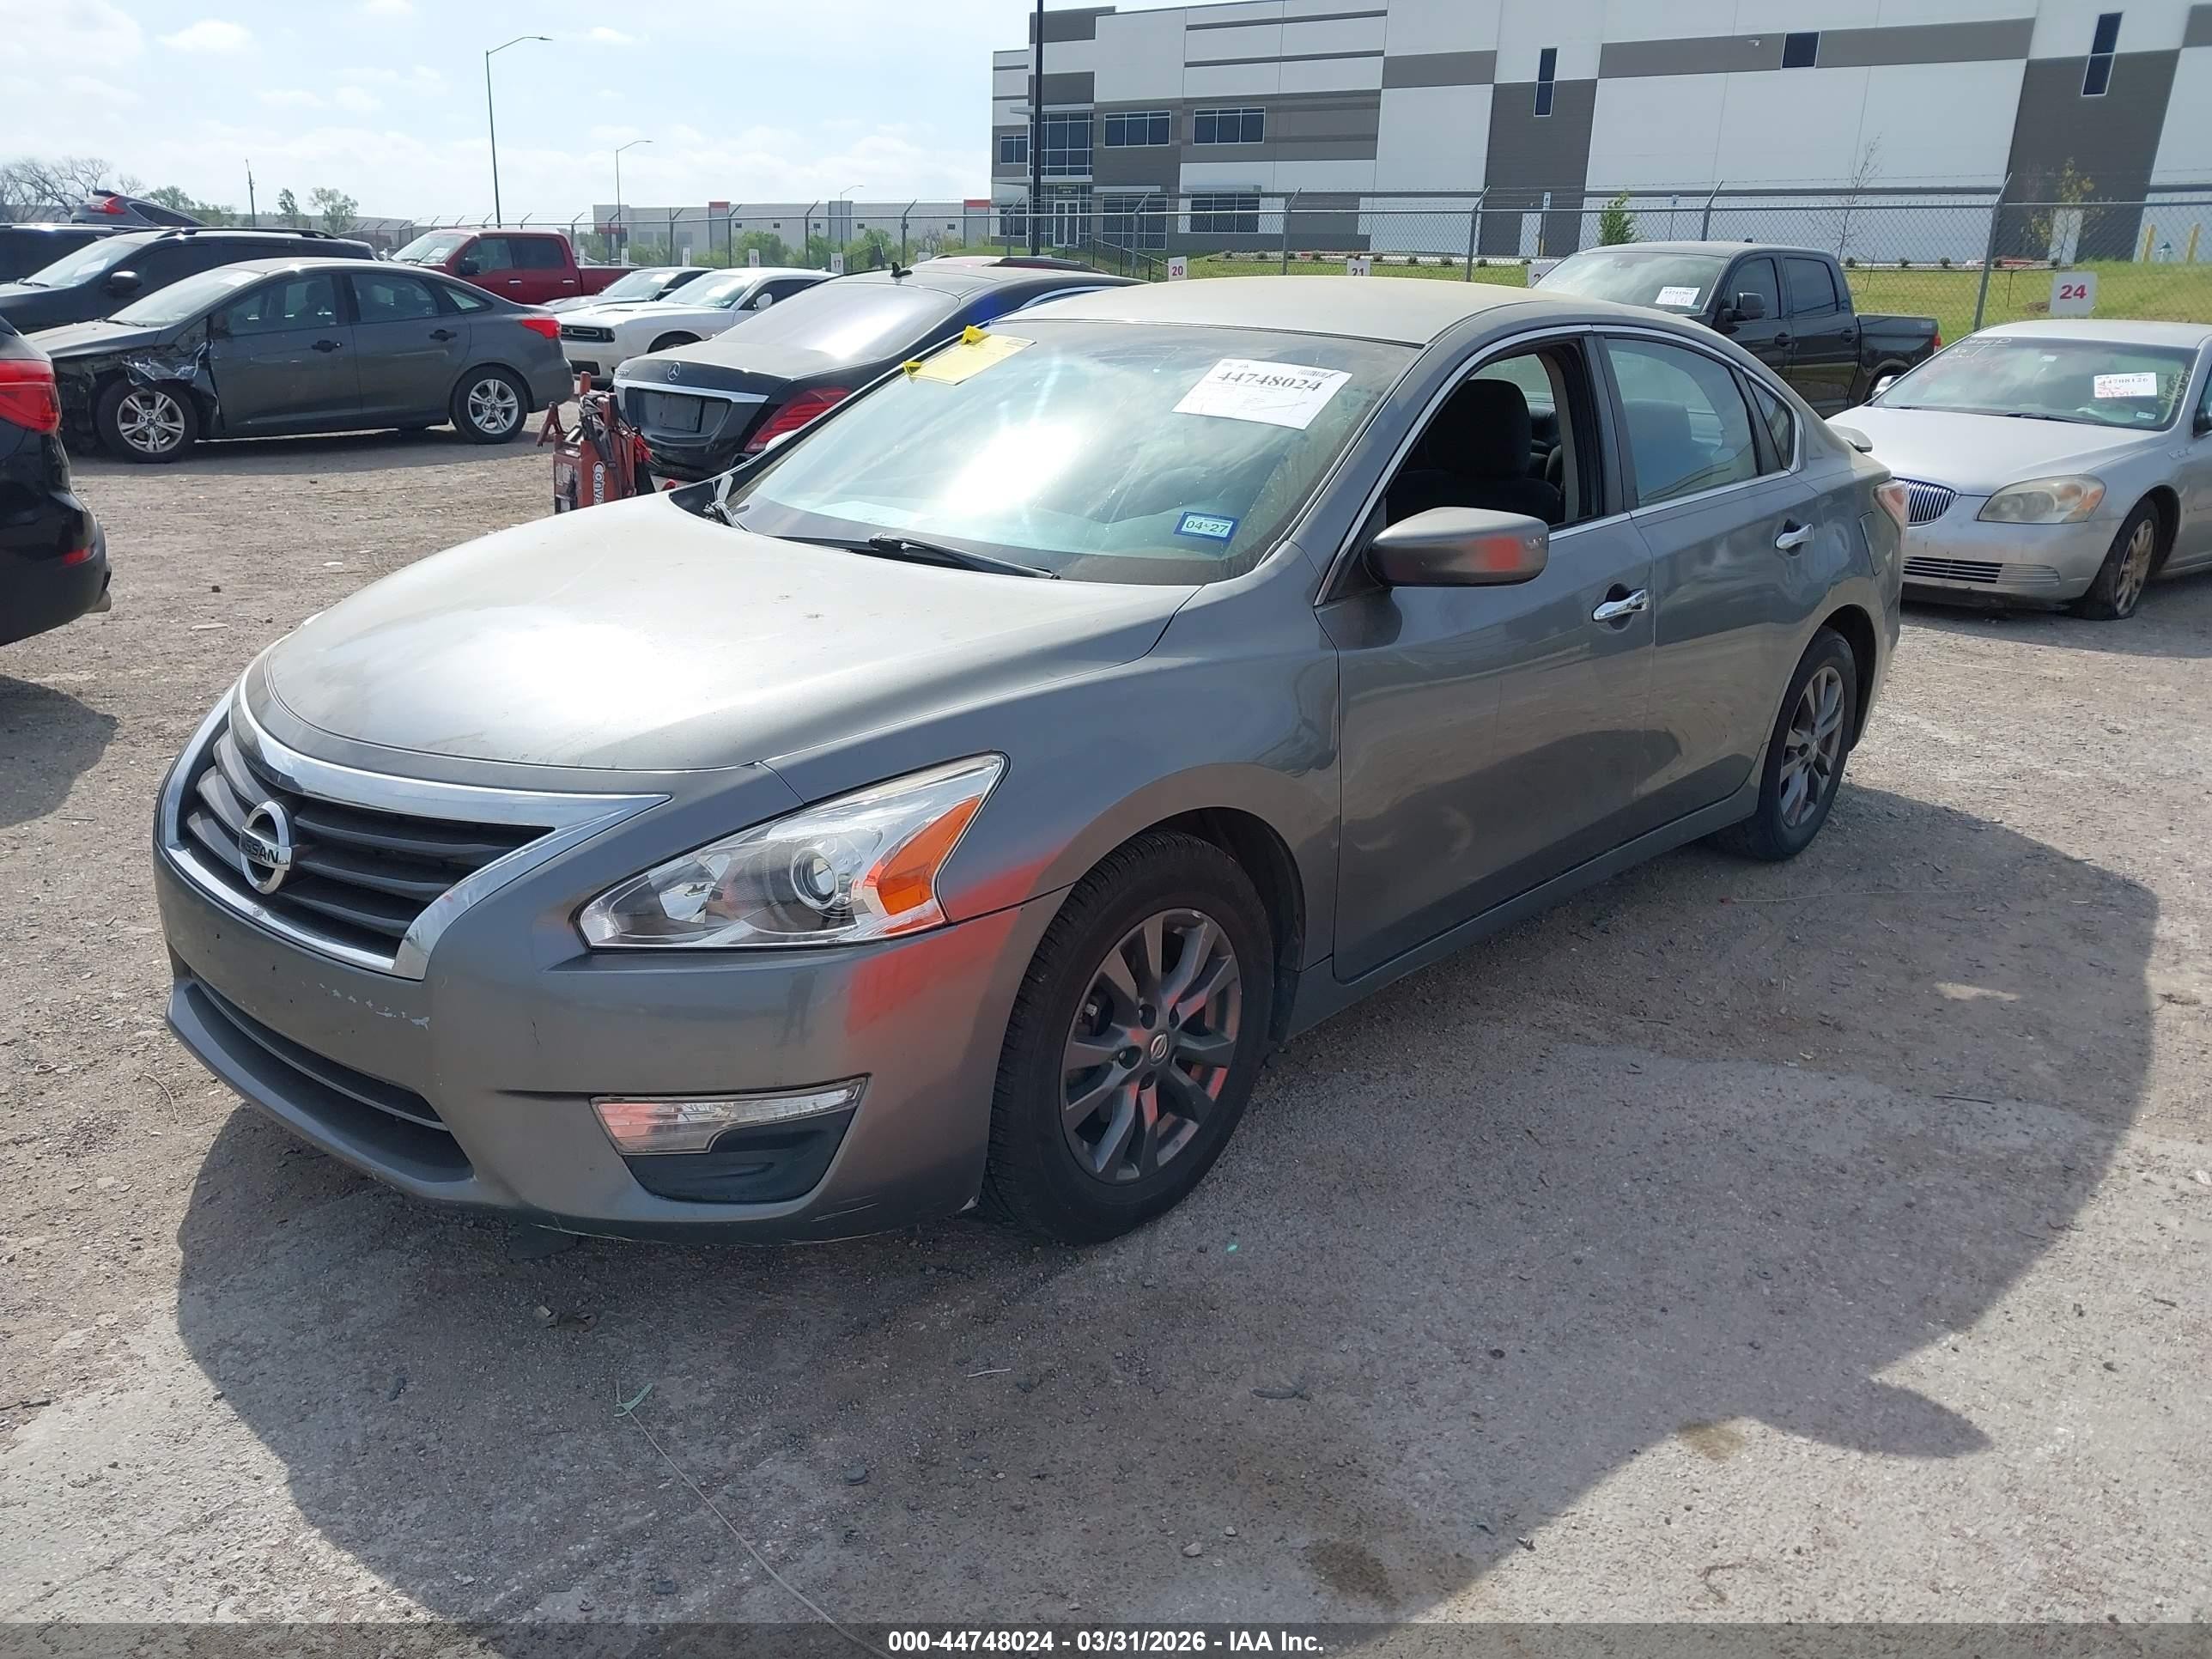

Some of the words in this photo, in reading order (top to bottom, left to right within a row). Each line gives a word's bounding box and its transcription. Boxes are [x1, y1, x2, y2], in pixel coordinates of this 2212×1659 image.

[1171, 265, 1184, 276] 20
[1352, 267, 1364, 276] 21
[2059, 284, 2087, 300] 24
[1217, 371, 1323, 392] 44748024
[241, 835, 279, 864] SSAN
